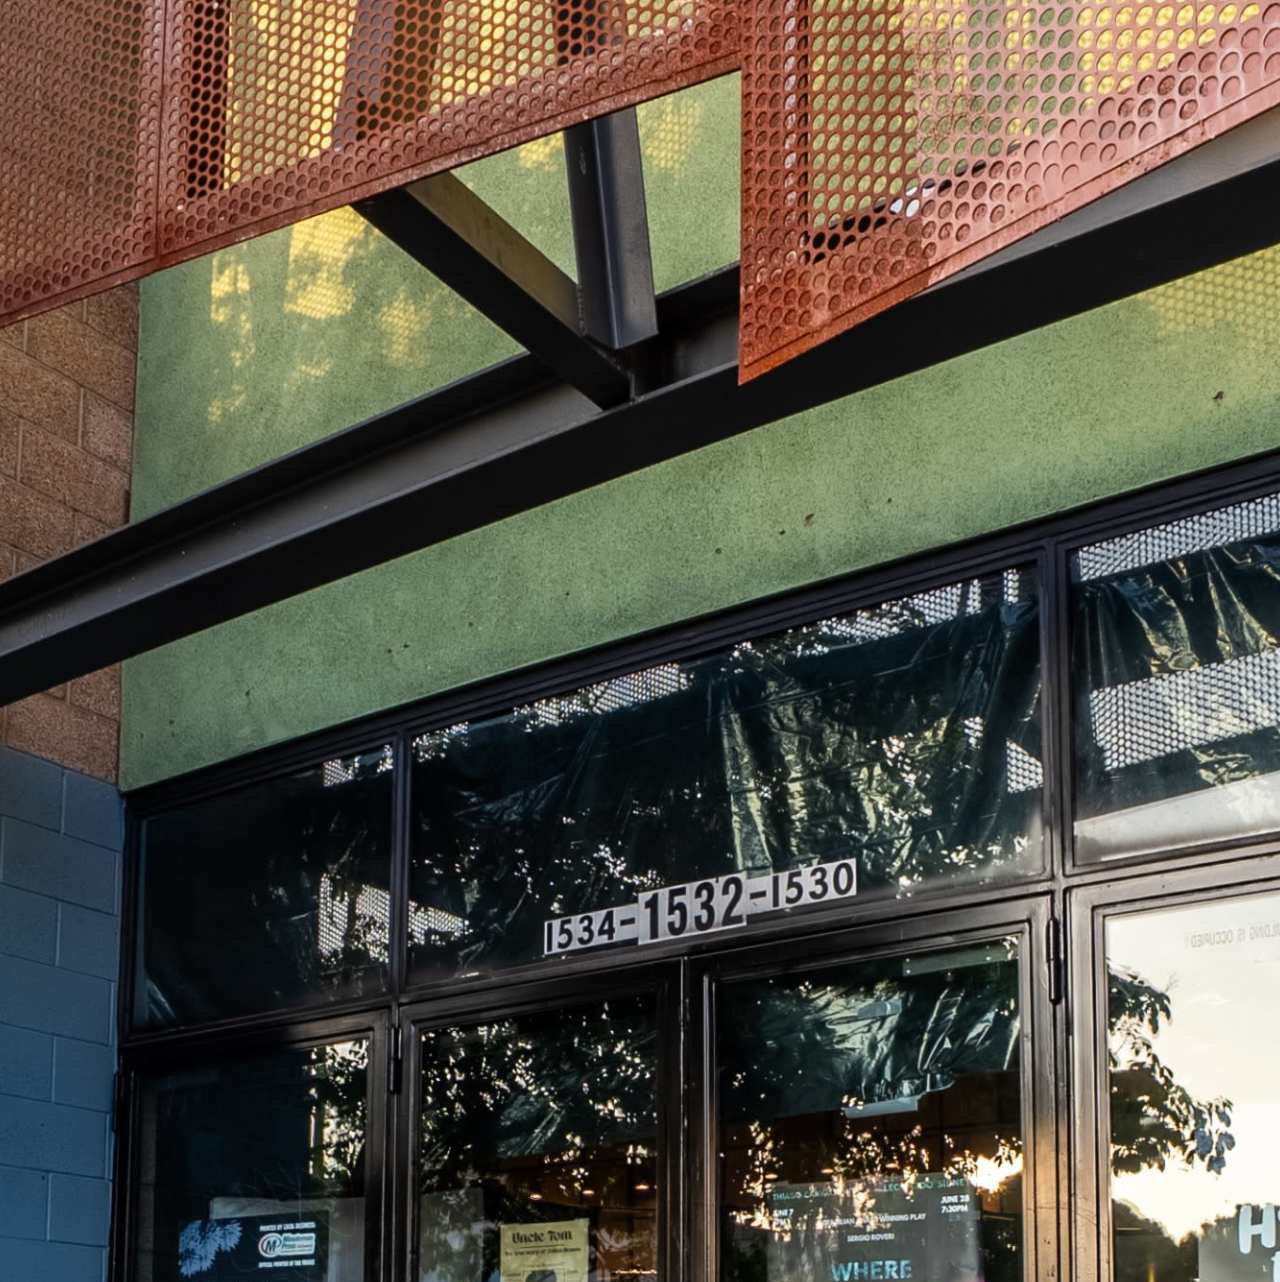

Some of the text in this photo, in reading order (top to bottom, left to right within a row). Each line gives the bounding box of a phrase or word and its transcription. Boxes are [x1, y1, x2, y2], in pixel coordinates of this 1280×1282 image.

[512, 1230, 573, 1244] Uncle Tom
[831, 1260, 912, 1282] WHERE
